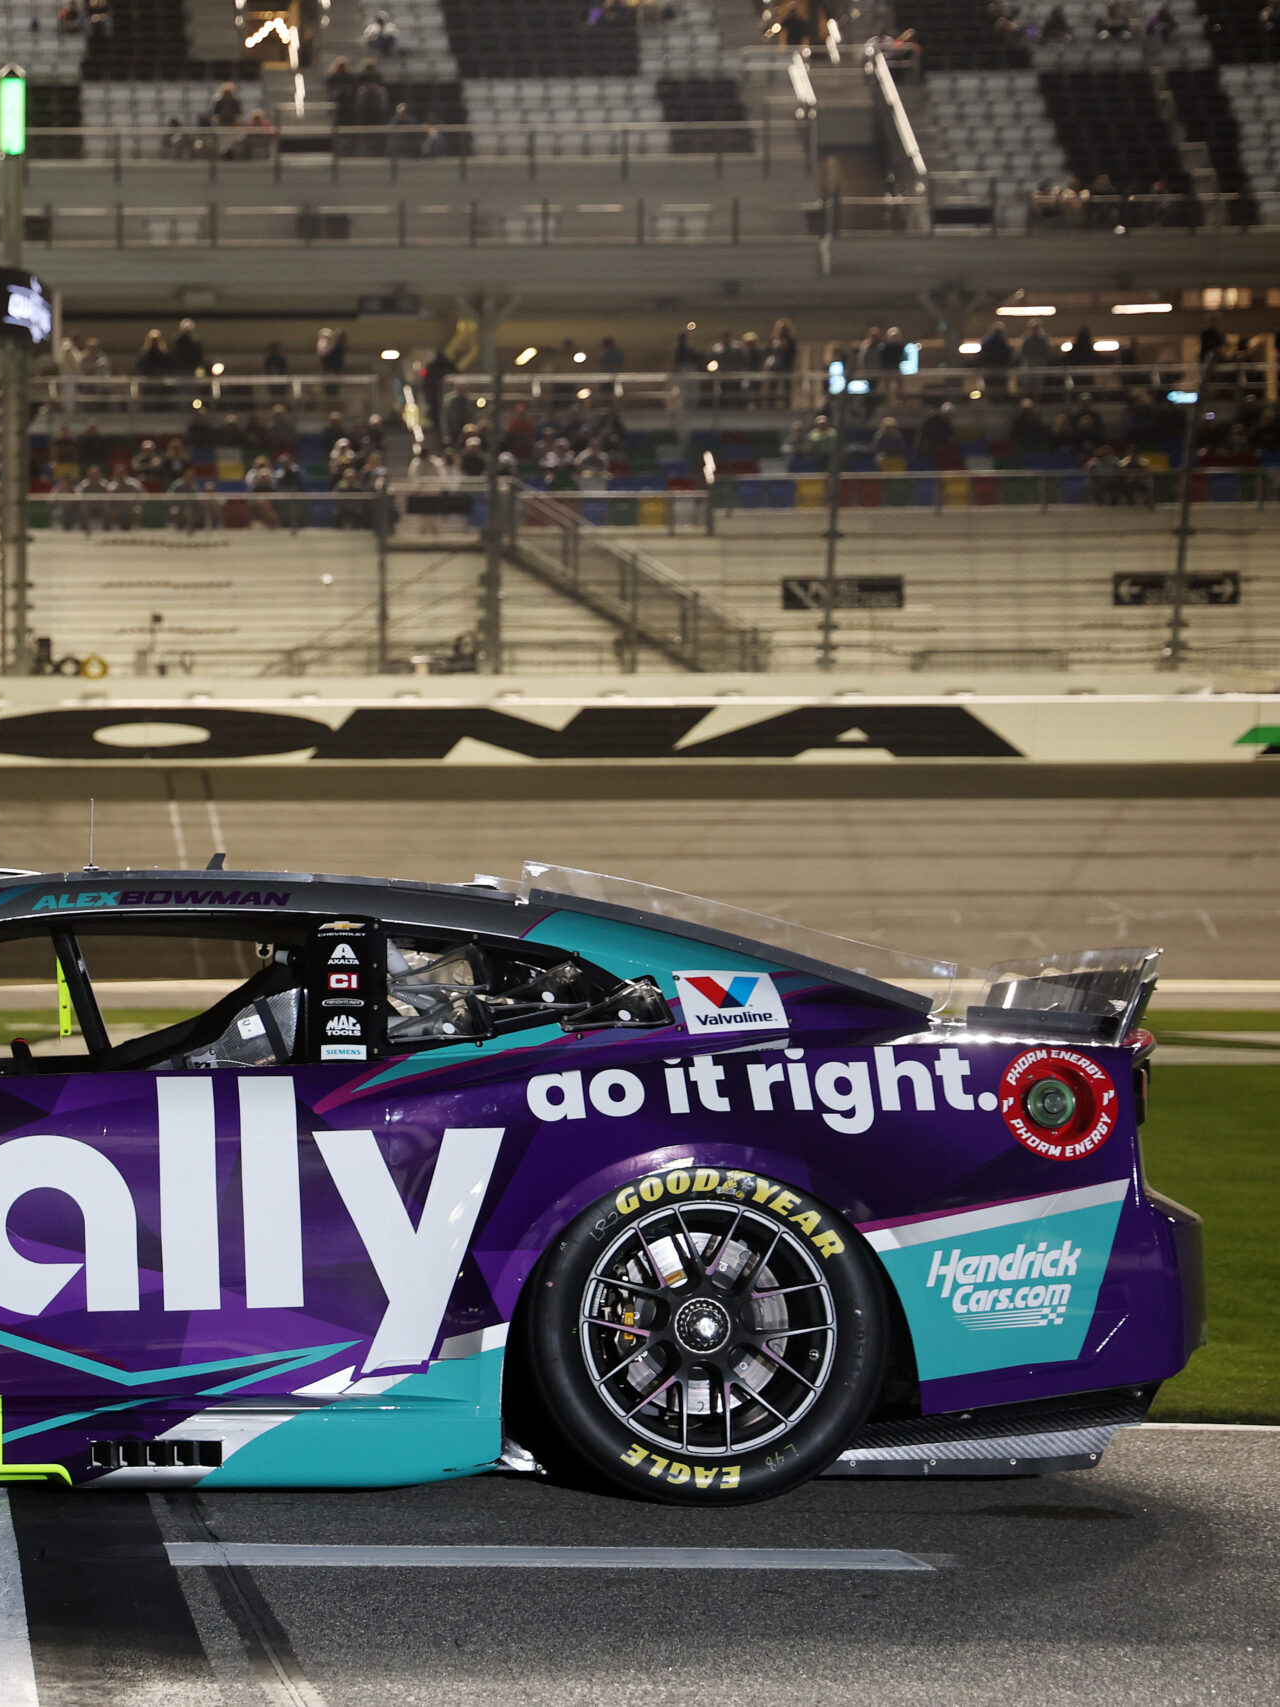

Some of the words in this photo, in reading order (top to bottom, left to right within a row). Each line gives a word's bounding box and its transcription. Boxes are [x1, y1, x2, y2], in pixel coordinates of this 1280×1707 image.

[31, 891, 120, 911] ALEX
[118, 890, 292, 907] BOWMAN
[329, 973, 358, 989] CI
[325, 1014, 362, 1030] MAC
[695, 1011, 773, 1026] Valvoline
[325, 1048, 362, 1056] SIEMENS
[1005, 1049, 1049, 1087] PHORM
[1050, 1049, 1107, 1080] ENERGY
[526, 1068, 646, 1122] do
[662, 1055, 731, 1114] it
[746, 1046, 998, 1134] right.
[1009, 1118, 1063, 1157] PHORM
[1064, 1111, 1112, 1158] ENERGY
[925, 1240, 1082, 1298] Hendrick
[952, 1283, 1072, 1314] Cars.com
[620, 1442, 742, 1489] EAGLE
